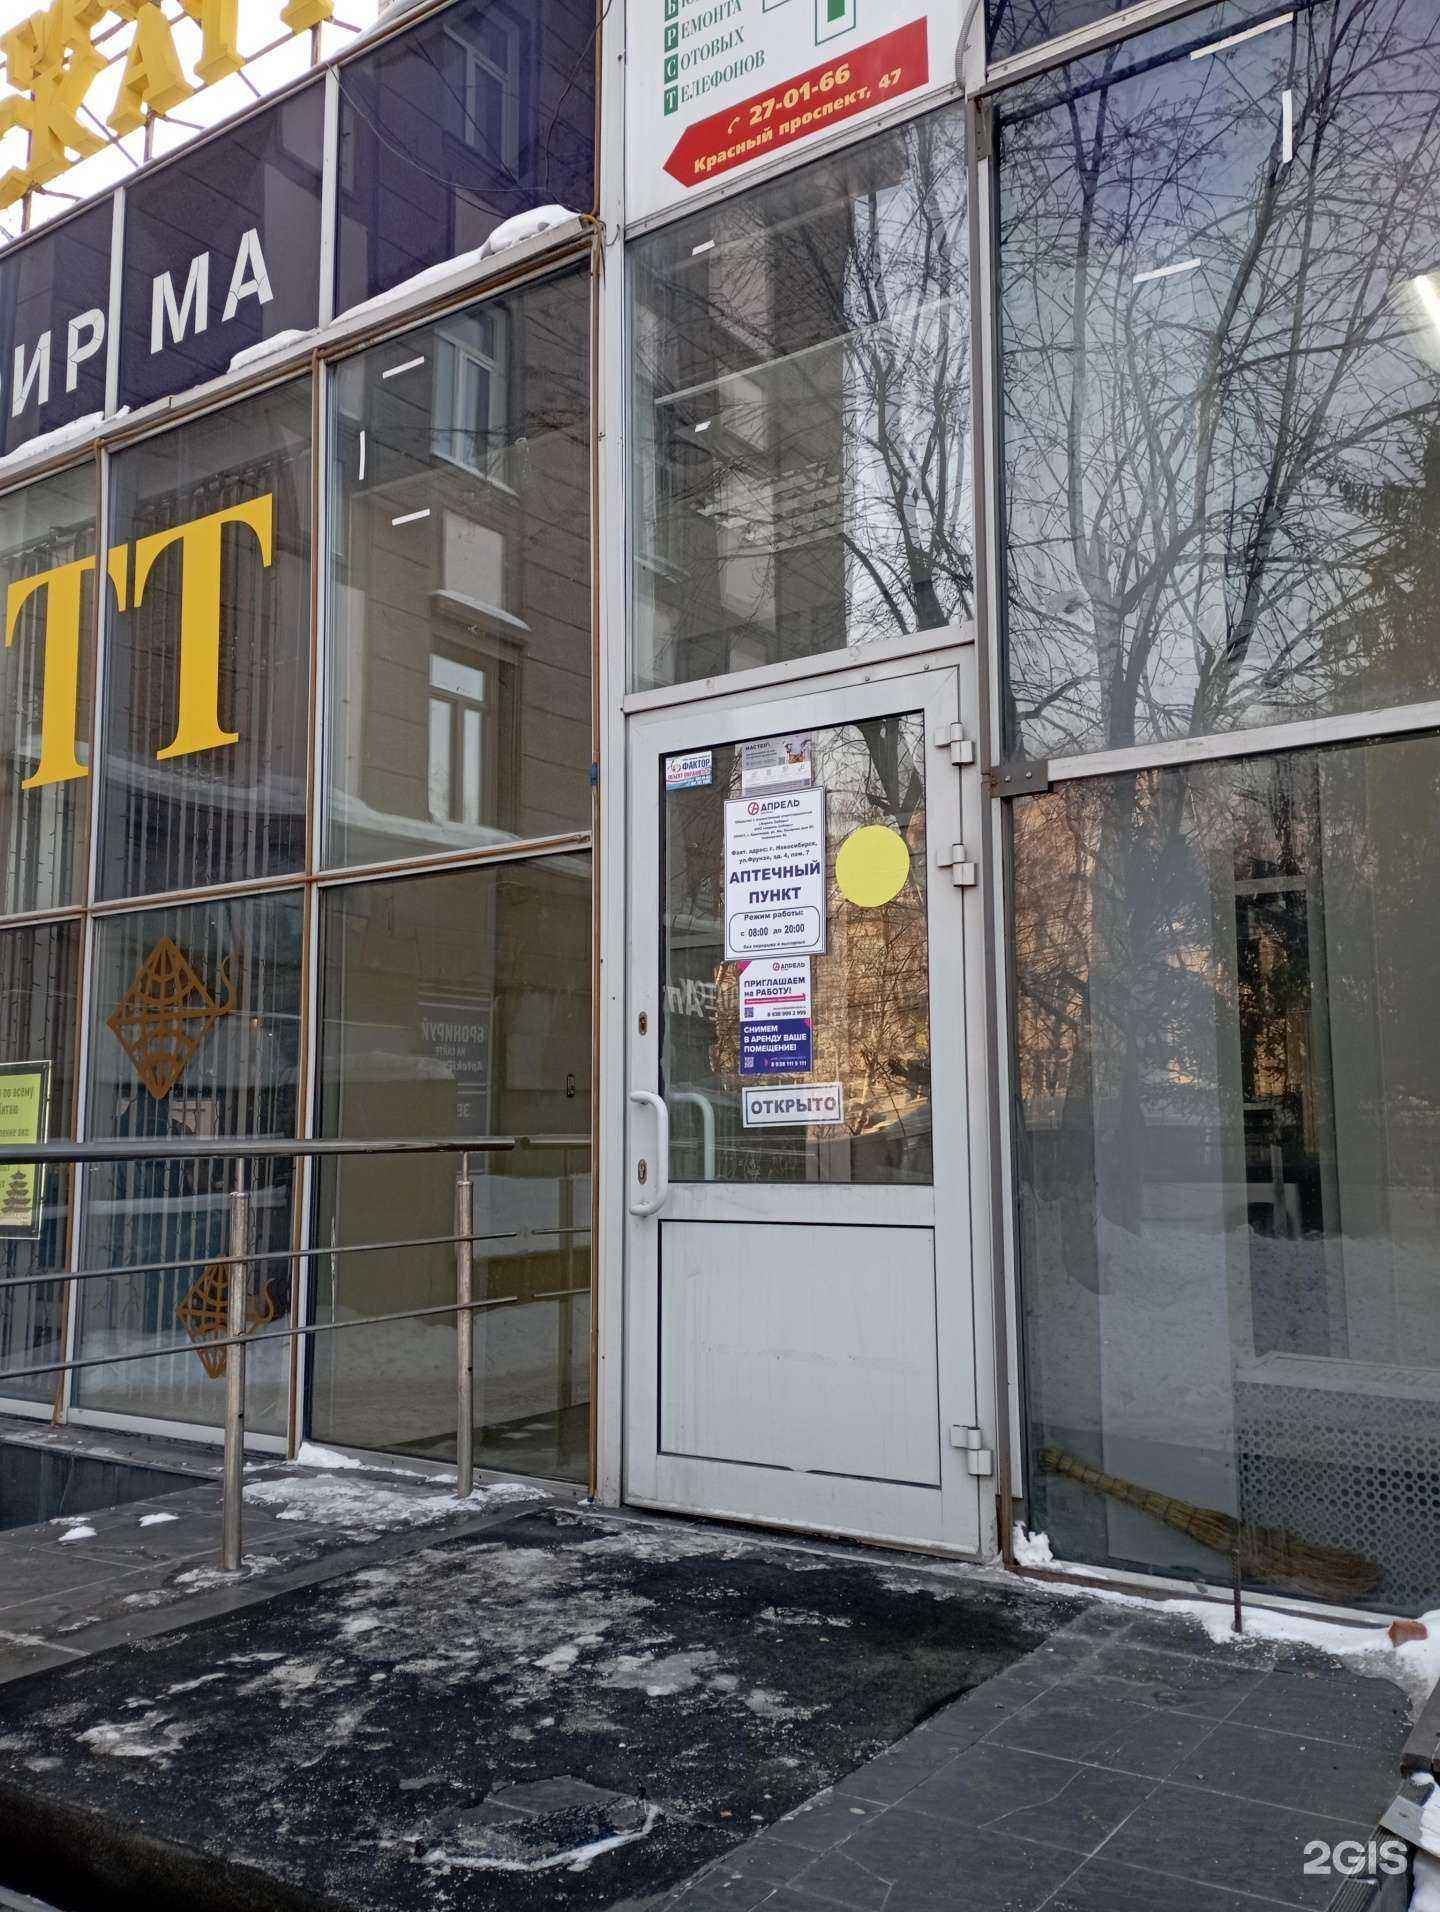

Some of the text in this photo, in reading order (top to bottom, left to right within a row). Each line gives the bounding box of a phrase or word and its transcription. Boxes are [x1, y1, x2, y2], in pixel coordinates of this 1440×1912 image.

[665, 0, 743, 48] РЕМОНТА
[666, 25, 744, 78] СОТОВЫХ
[665, 49, 766, 111] ТЕЛЕФОНОВ
[749, 63, 851, 126] 27-01-66
[693, 68, 903, 174] Красный проспект, 47
[682, 759, 710, 770] ФАКТОР
[761, 799, 800, 811] АПРЕЛЬ
[729, 859, 821, 884] АПТЕЧНЫЙ
[749, 886, 802, 904] ПУНКТ
[744, 909, 804, 921] Режим работы:
[748, 927, 769, 937] 08:00
[784, 923, 805, 934] 20:00
[781, 962, 806, 970] АПРЕЛЬ
[744, 976, 806, 988] ПРИГЛАШАЕМ
[756, 986, 792, 996] РАБОТУ!
[744, 1025, 778, 1034] СНИМЕМ
[751, 1034, 782, 1043] АРЕНДУ
[783, 1033, 807, 1041] ВАШЕ
[744, 1043, 797, 1053] ПОМЕЩЕНИЕ!
[750, 1096, 836, 1115] ОТКРЫТО
